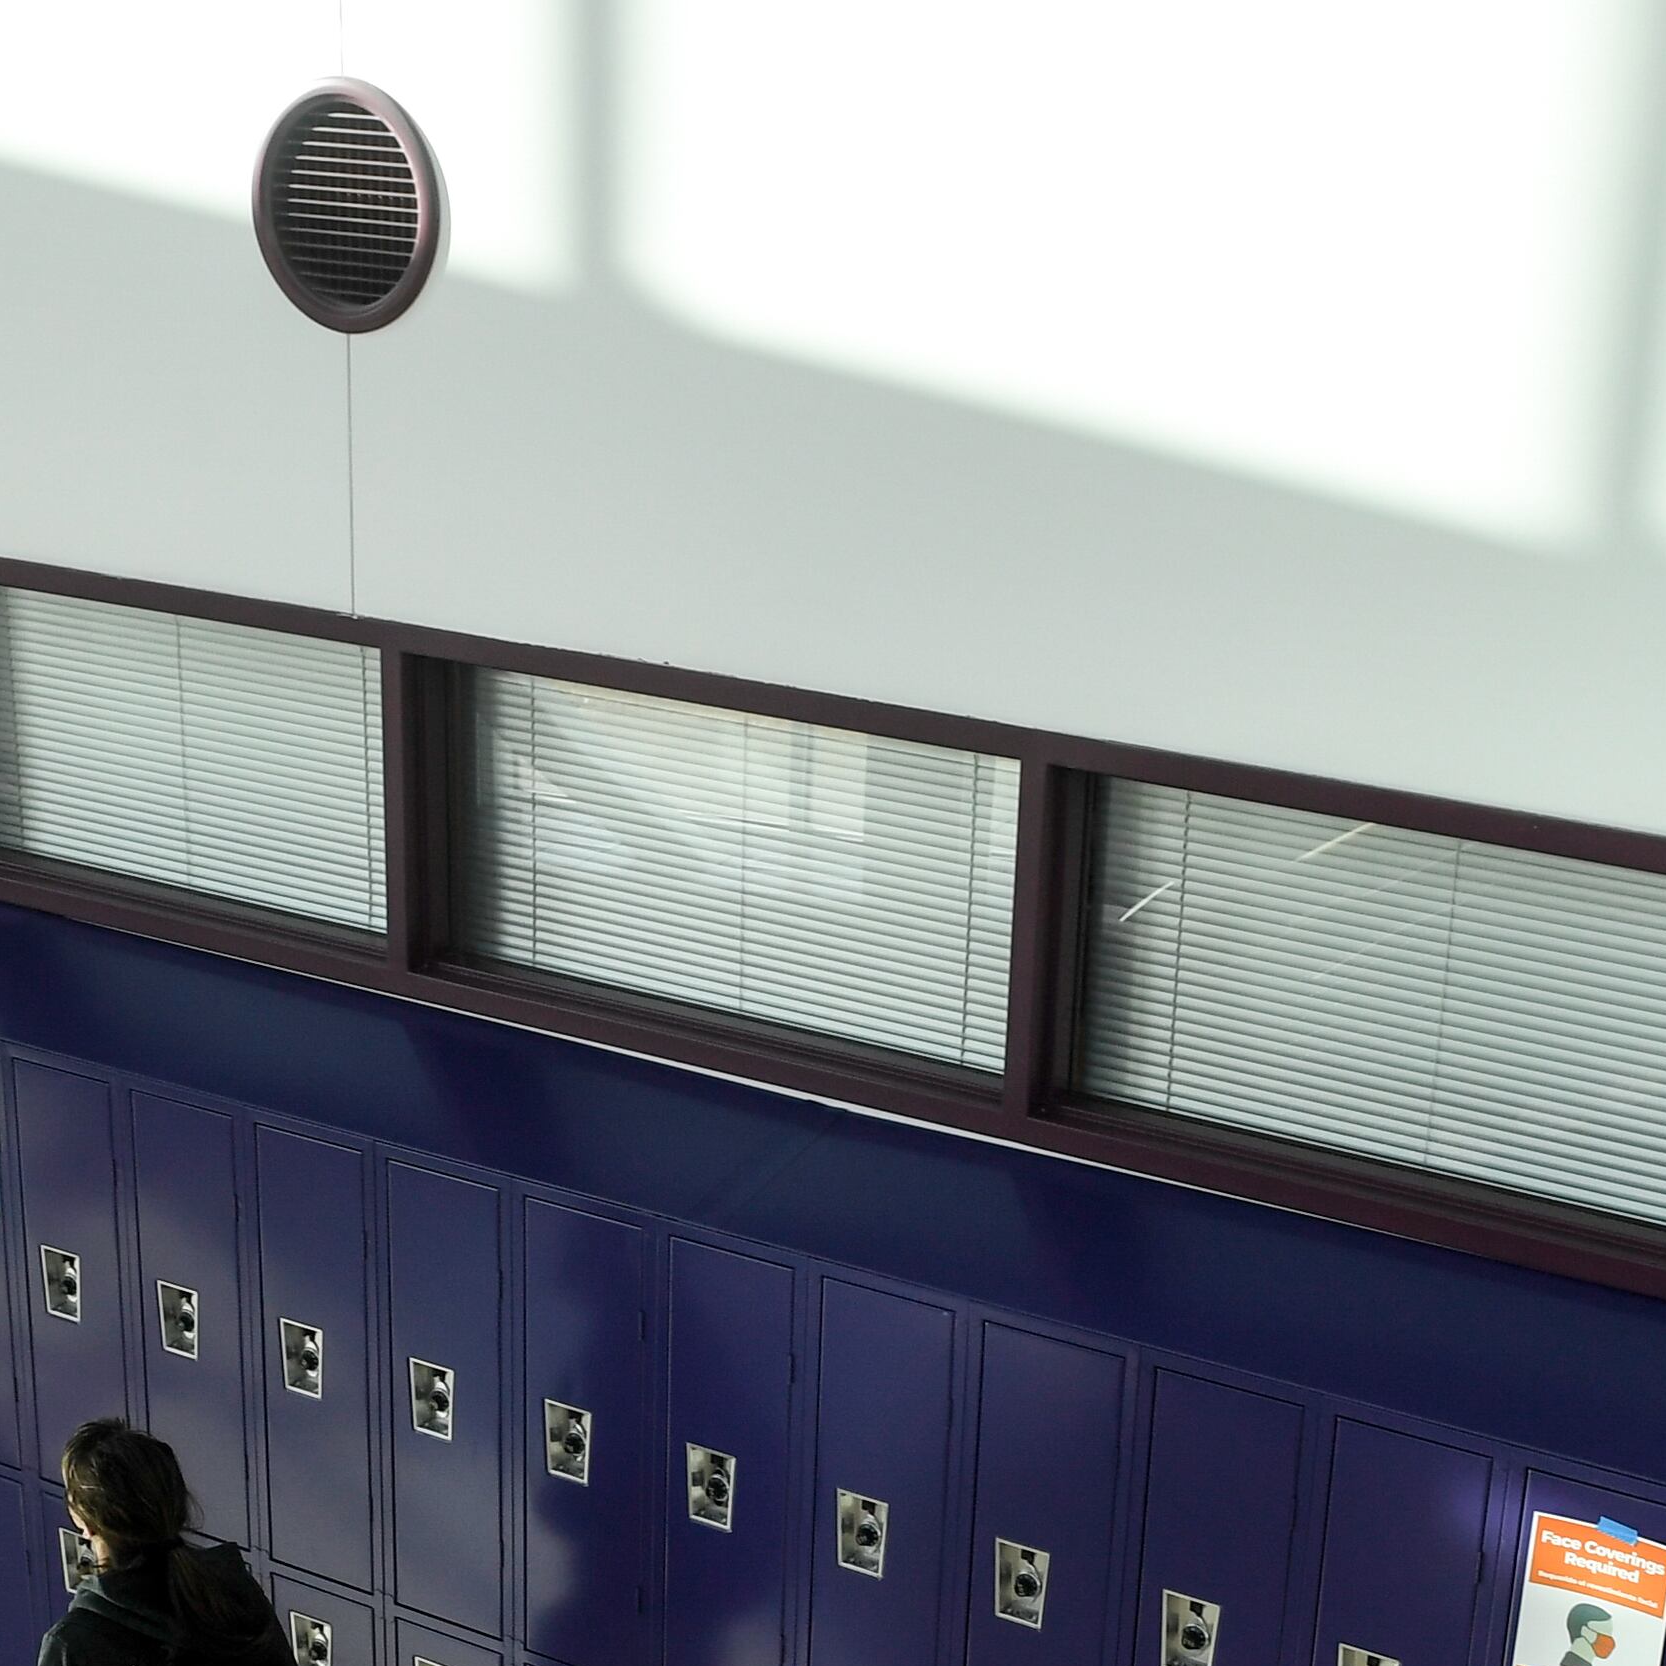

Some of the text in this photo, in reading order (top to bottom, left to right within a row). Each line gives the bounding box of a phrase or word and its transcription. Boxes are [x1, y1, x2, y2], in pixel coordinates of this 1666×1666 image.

[1541, 1529, 1666, 1576] Face Coverings
[1564, 1551, 1640, 1584] Required
